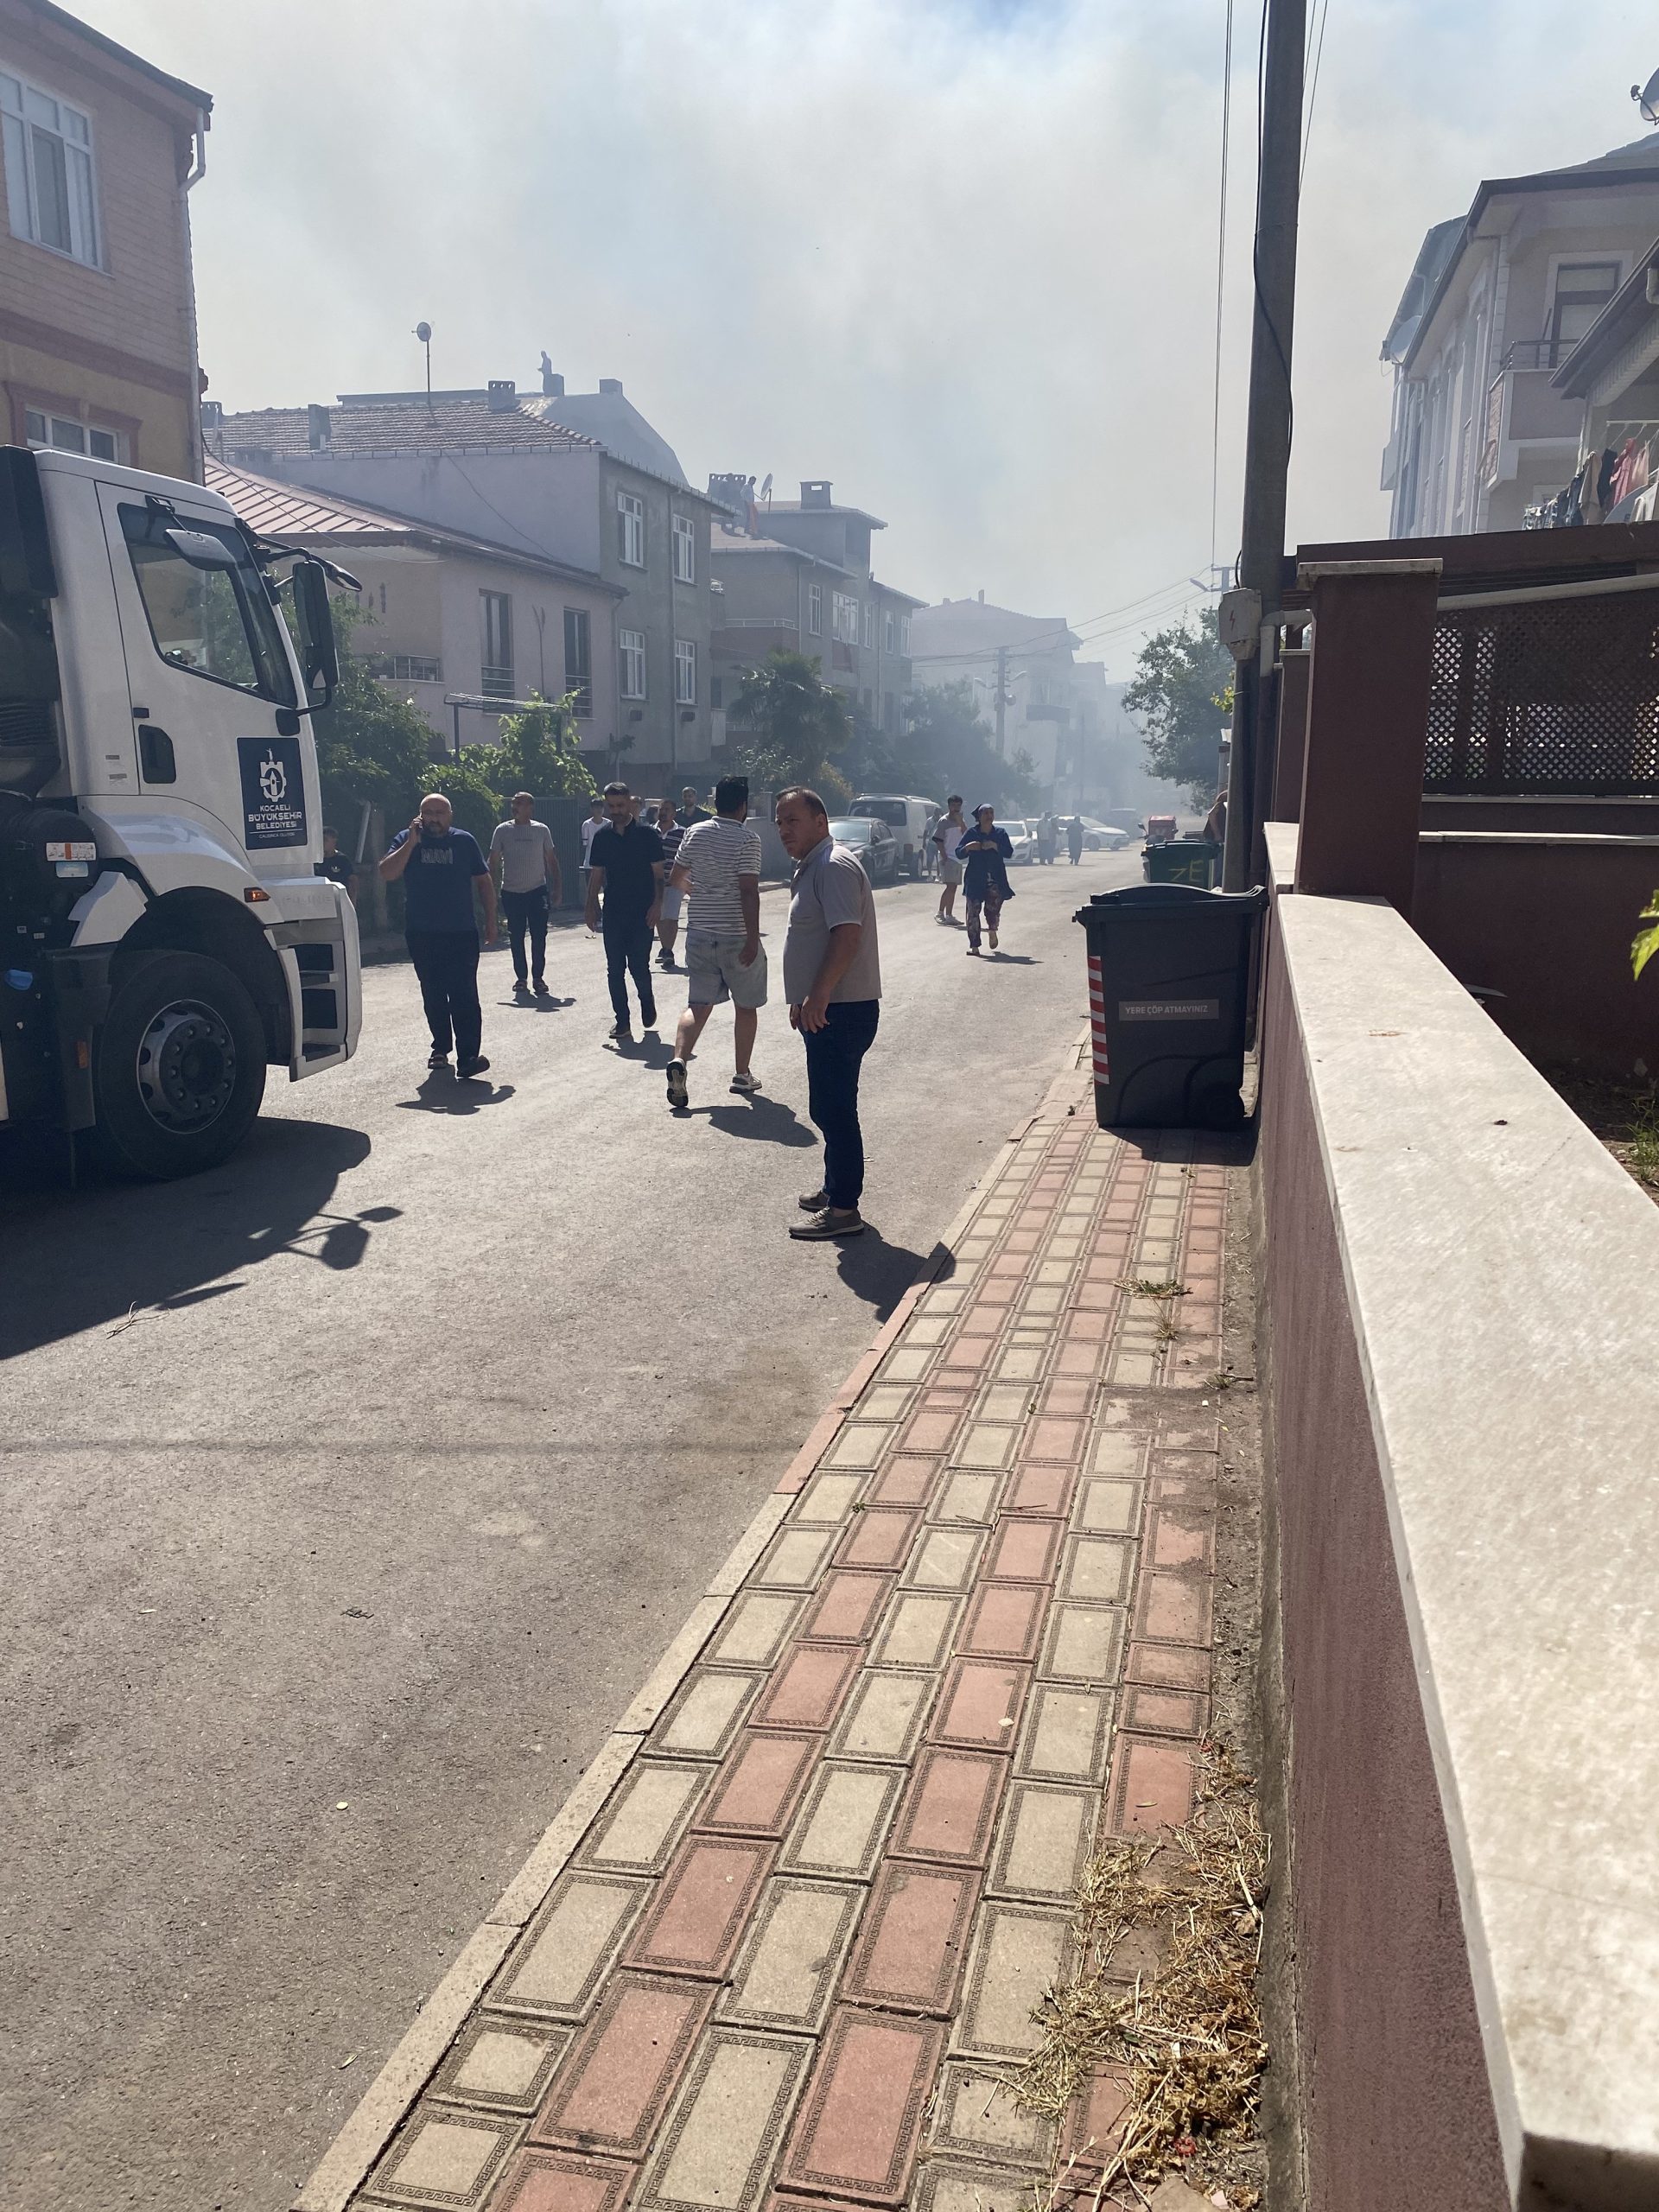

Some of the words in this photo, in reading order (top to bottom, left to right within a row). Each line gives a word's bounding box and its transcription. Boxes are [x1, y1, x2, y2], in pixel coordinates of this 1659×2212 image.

[248, 811, 302, 822] BÜYÜKŞEHİR
[256, 821, 296, 830] BELEDİYESİ
[1147, 1005, 1163, 1015] ÇÖP
[1164, 1005, 1209, 1014] ATMAYINIZ
